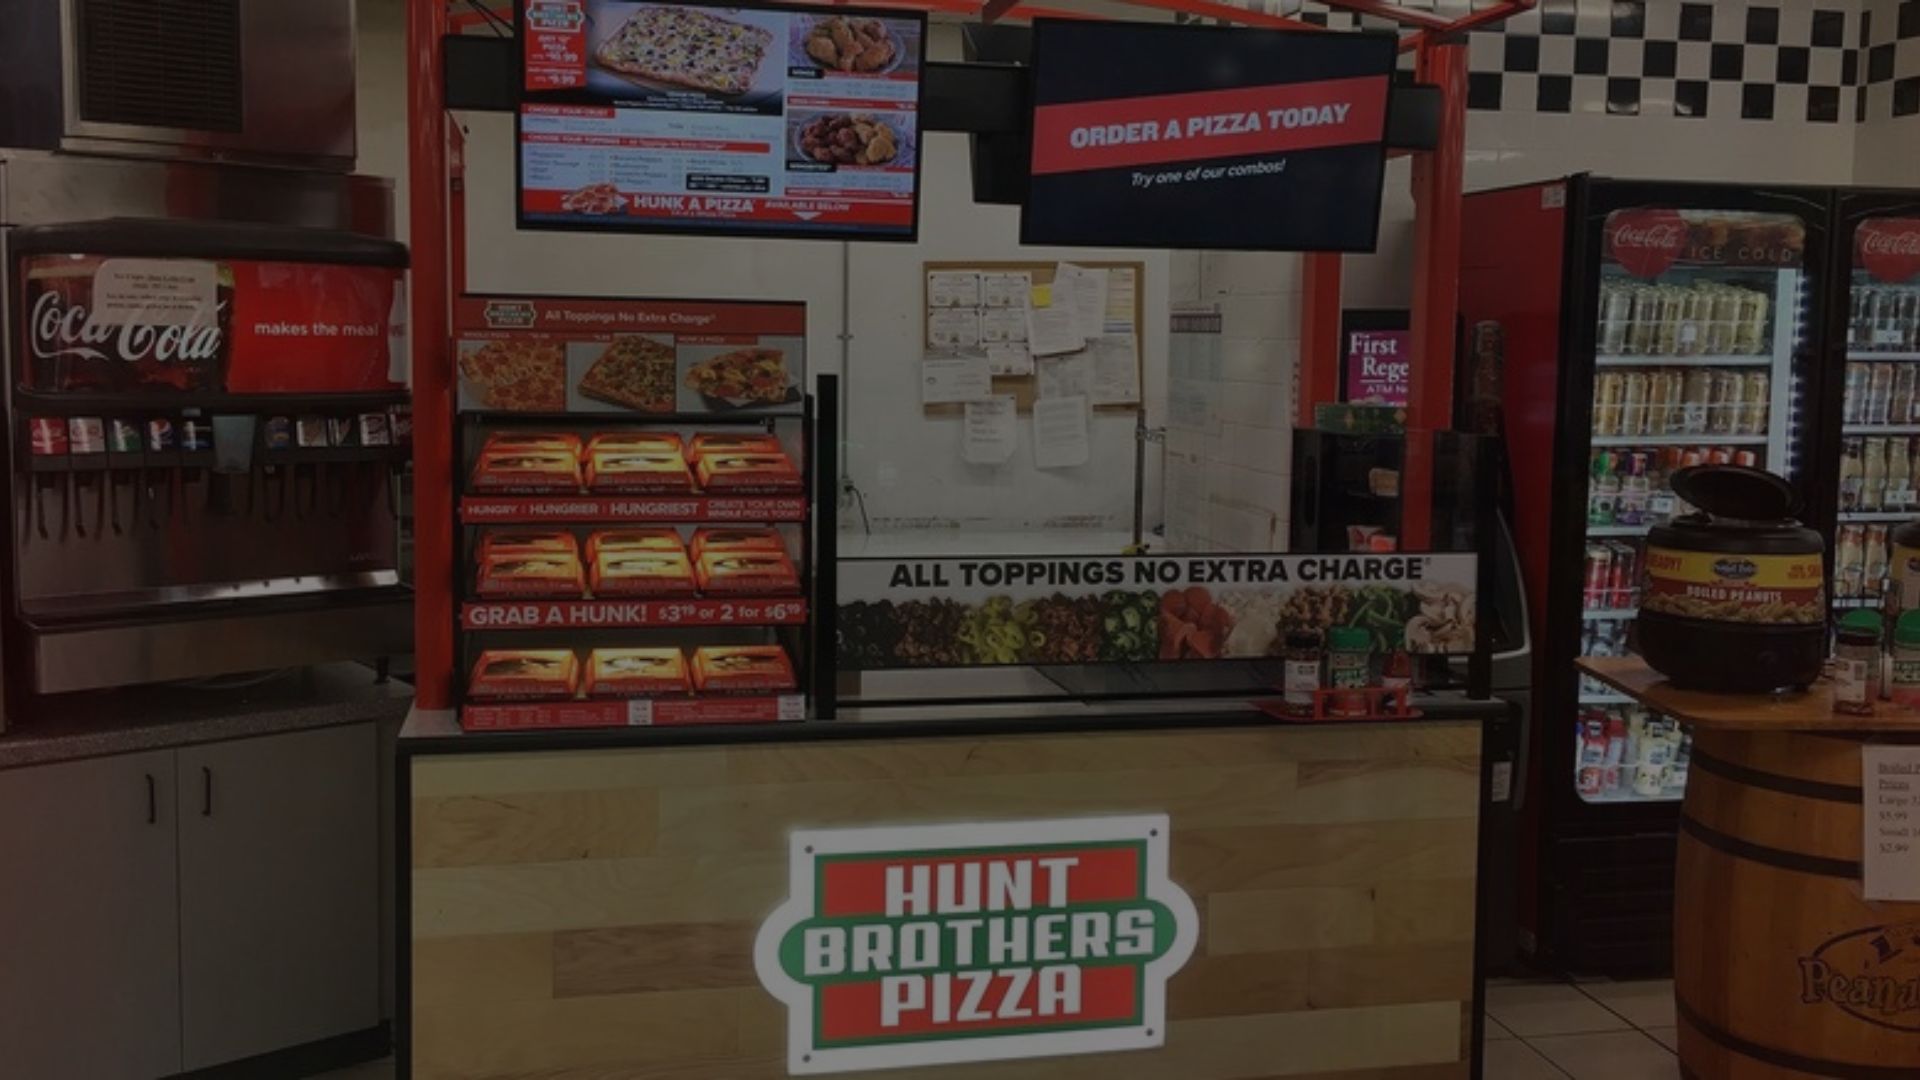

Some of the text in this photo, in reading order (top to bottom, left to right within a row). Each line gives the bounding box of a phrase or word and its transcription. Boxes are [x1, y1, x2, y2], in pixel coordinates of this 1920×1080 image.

[1070, 103, 1351, 149] ORDER A PIZZA TODAY
[1131, 158, 1286, 188] Try one of our combos!
[633, 194, 754, 213] HUNK A PIZZA
[1691, 247, 1792, 262] ICE COLD
[545, 311, 561, 320] All
[564, 311, 616, 324] Toppings
[619, 312, 635, 321] No
[637, 312, 667, 323] Extra
[254, 322, 379, 338] makes the meal
[1350, 334, 1397, 355] First
[1366, 385, 1394, 394] ATM
[468, 502, 699, 516] HUNGRY HUNGRIER HUNGRIEST
[889, 563, 950, 588] ALL
[959, 560, 1125, 587] TOPPINGS
[1133, 560, 1182, 584] NO
[1188, 559, 1289, 583] EXTRA
[1686, 584, 1782, 602] BOILED PEANUTS
[469, 607, 539, 625] GRAB
[545, 607, 564, 624] A
[569, 605, 648, 623] HUNK!
[699, 608, 716, 619] or
[720, 605, 734, 619] 2
[738, 605, 760, 618] for
[885, 856, 1080, 918] HUNT
[803, 908, 1156, 977] BROTHERS
[880, 963, 1082, 1028] PIZZA
